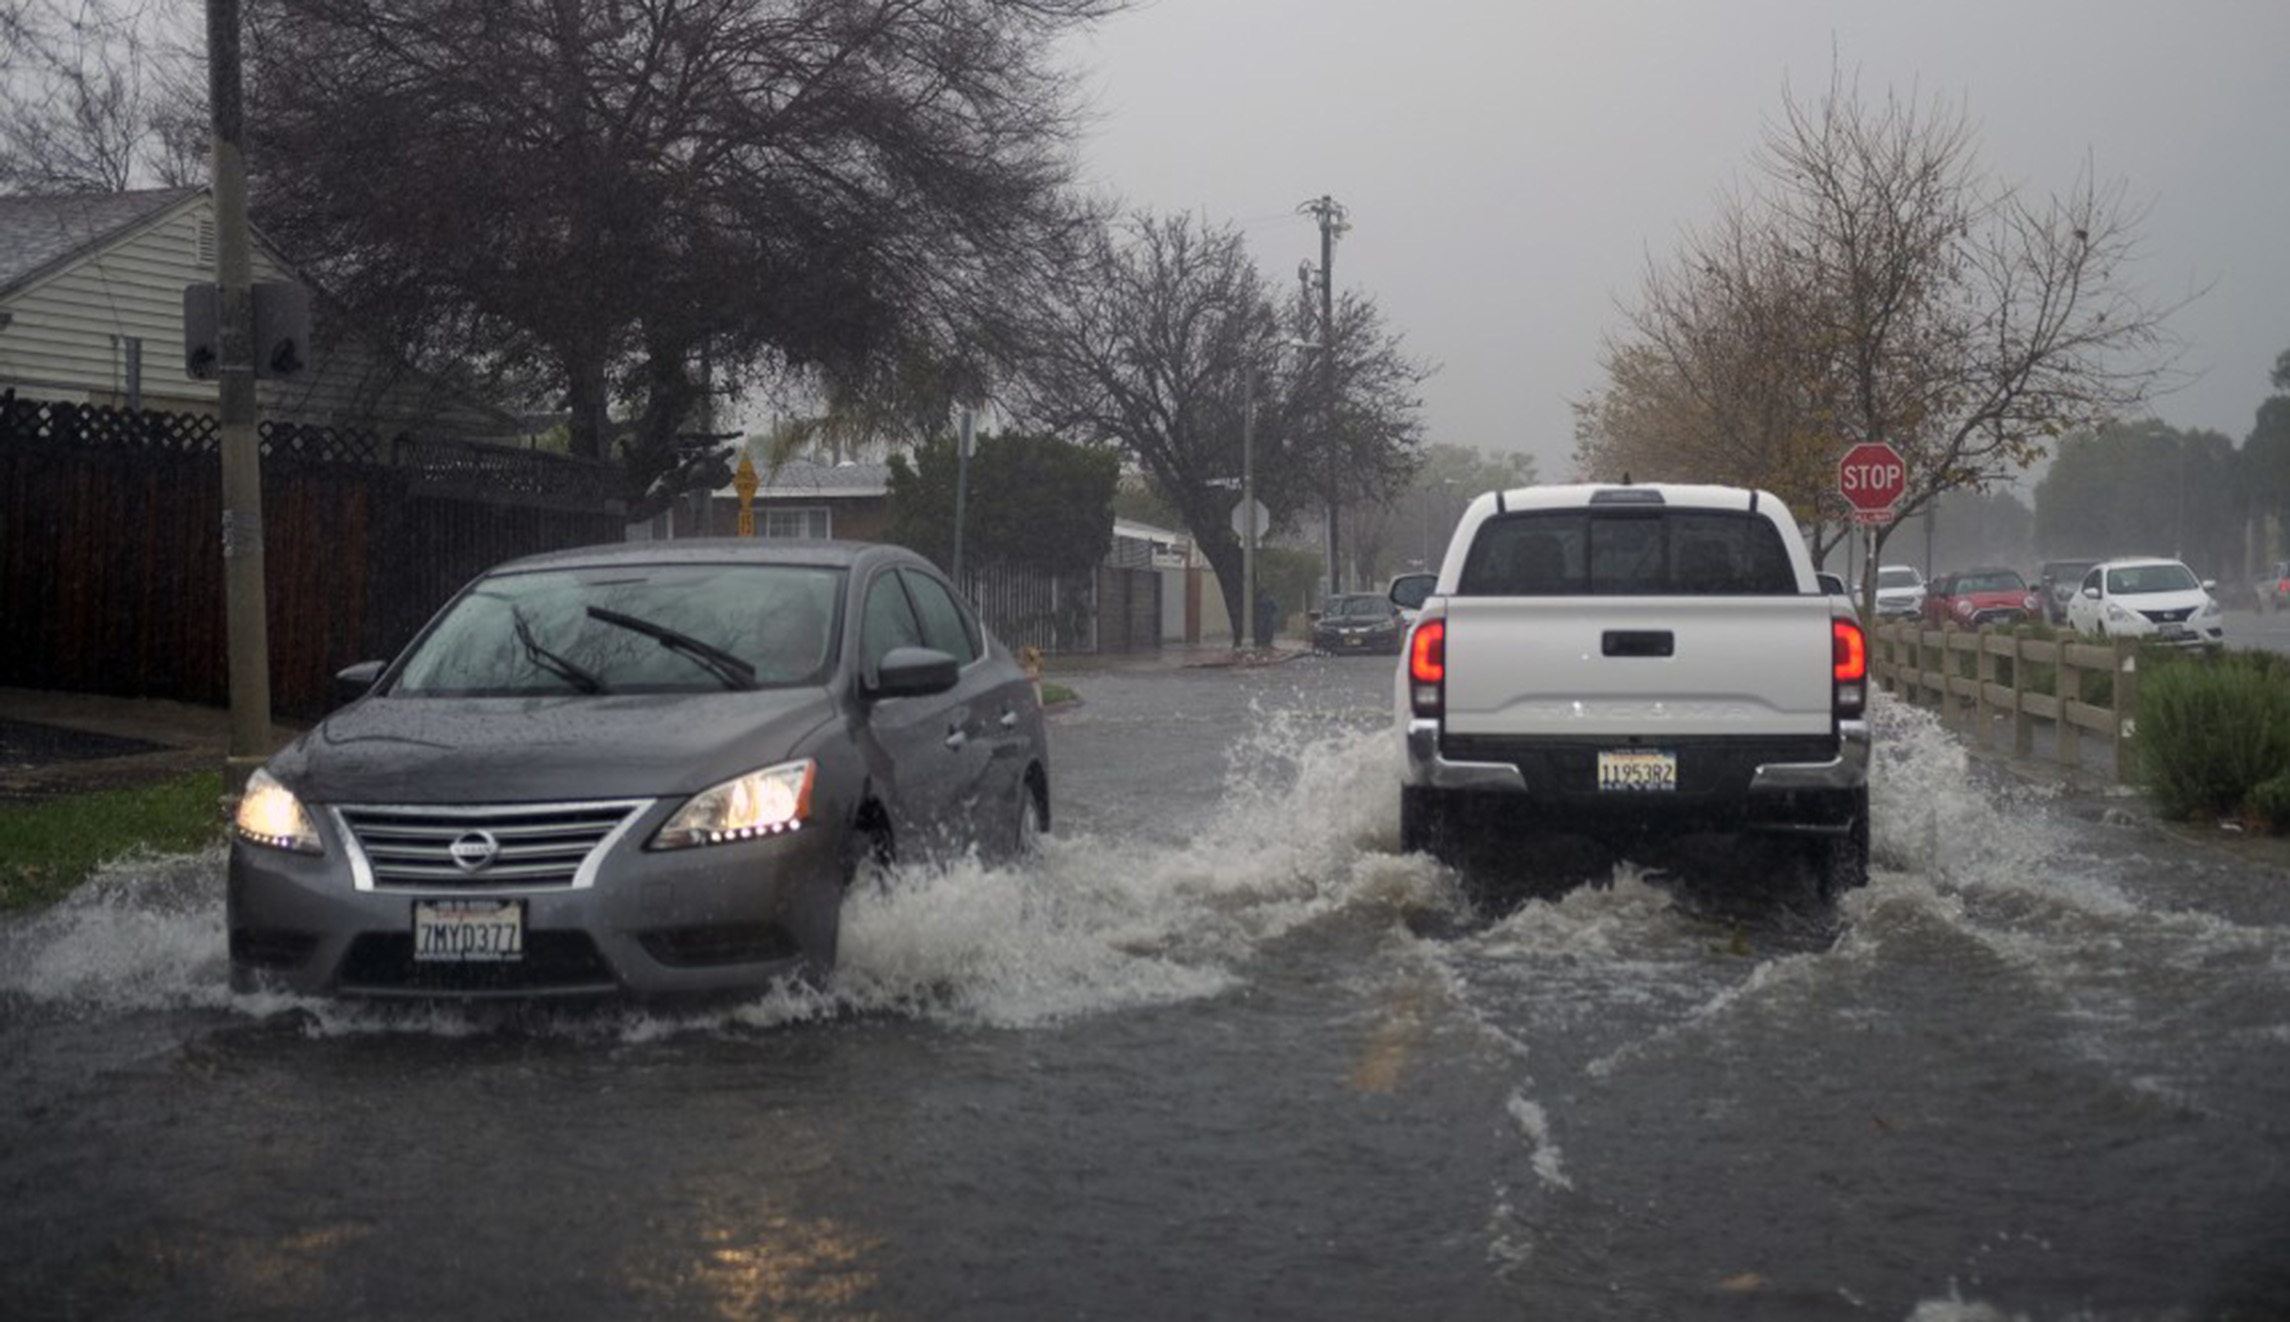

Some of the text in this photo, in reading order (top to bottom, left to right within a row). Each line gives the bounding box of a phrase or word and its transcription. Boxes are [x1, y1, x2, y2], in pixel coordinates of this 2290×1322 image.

[1844, 464, 1901, 490] STOP
[1602, 763, 1673, 783] 11953R2
[420, 923, 517, 954] 7MYD377
